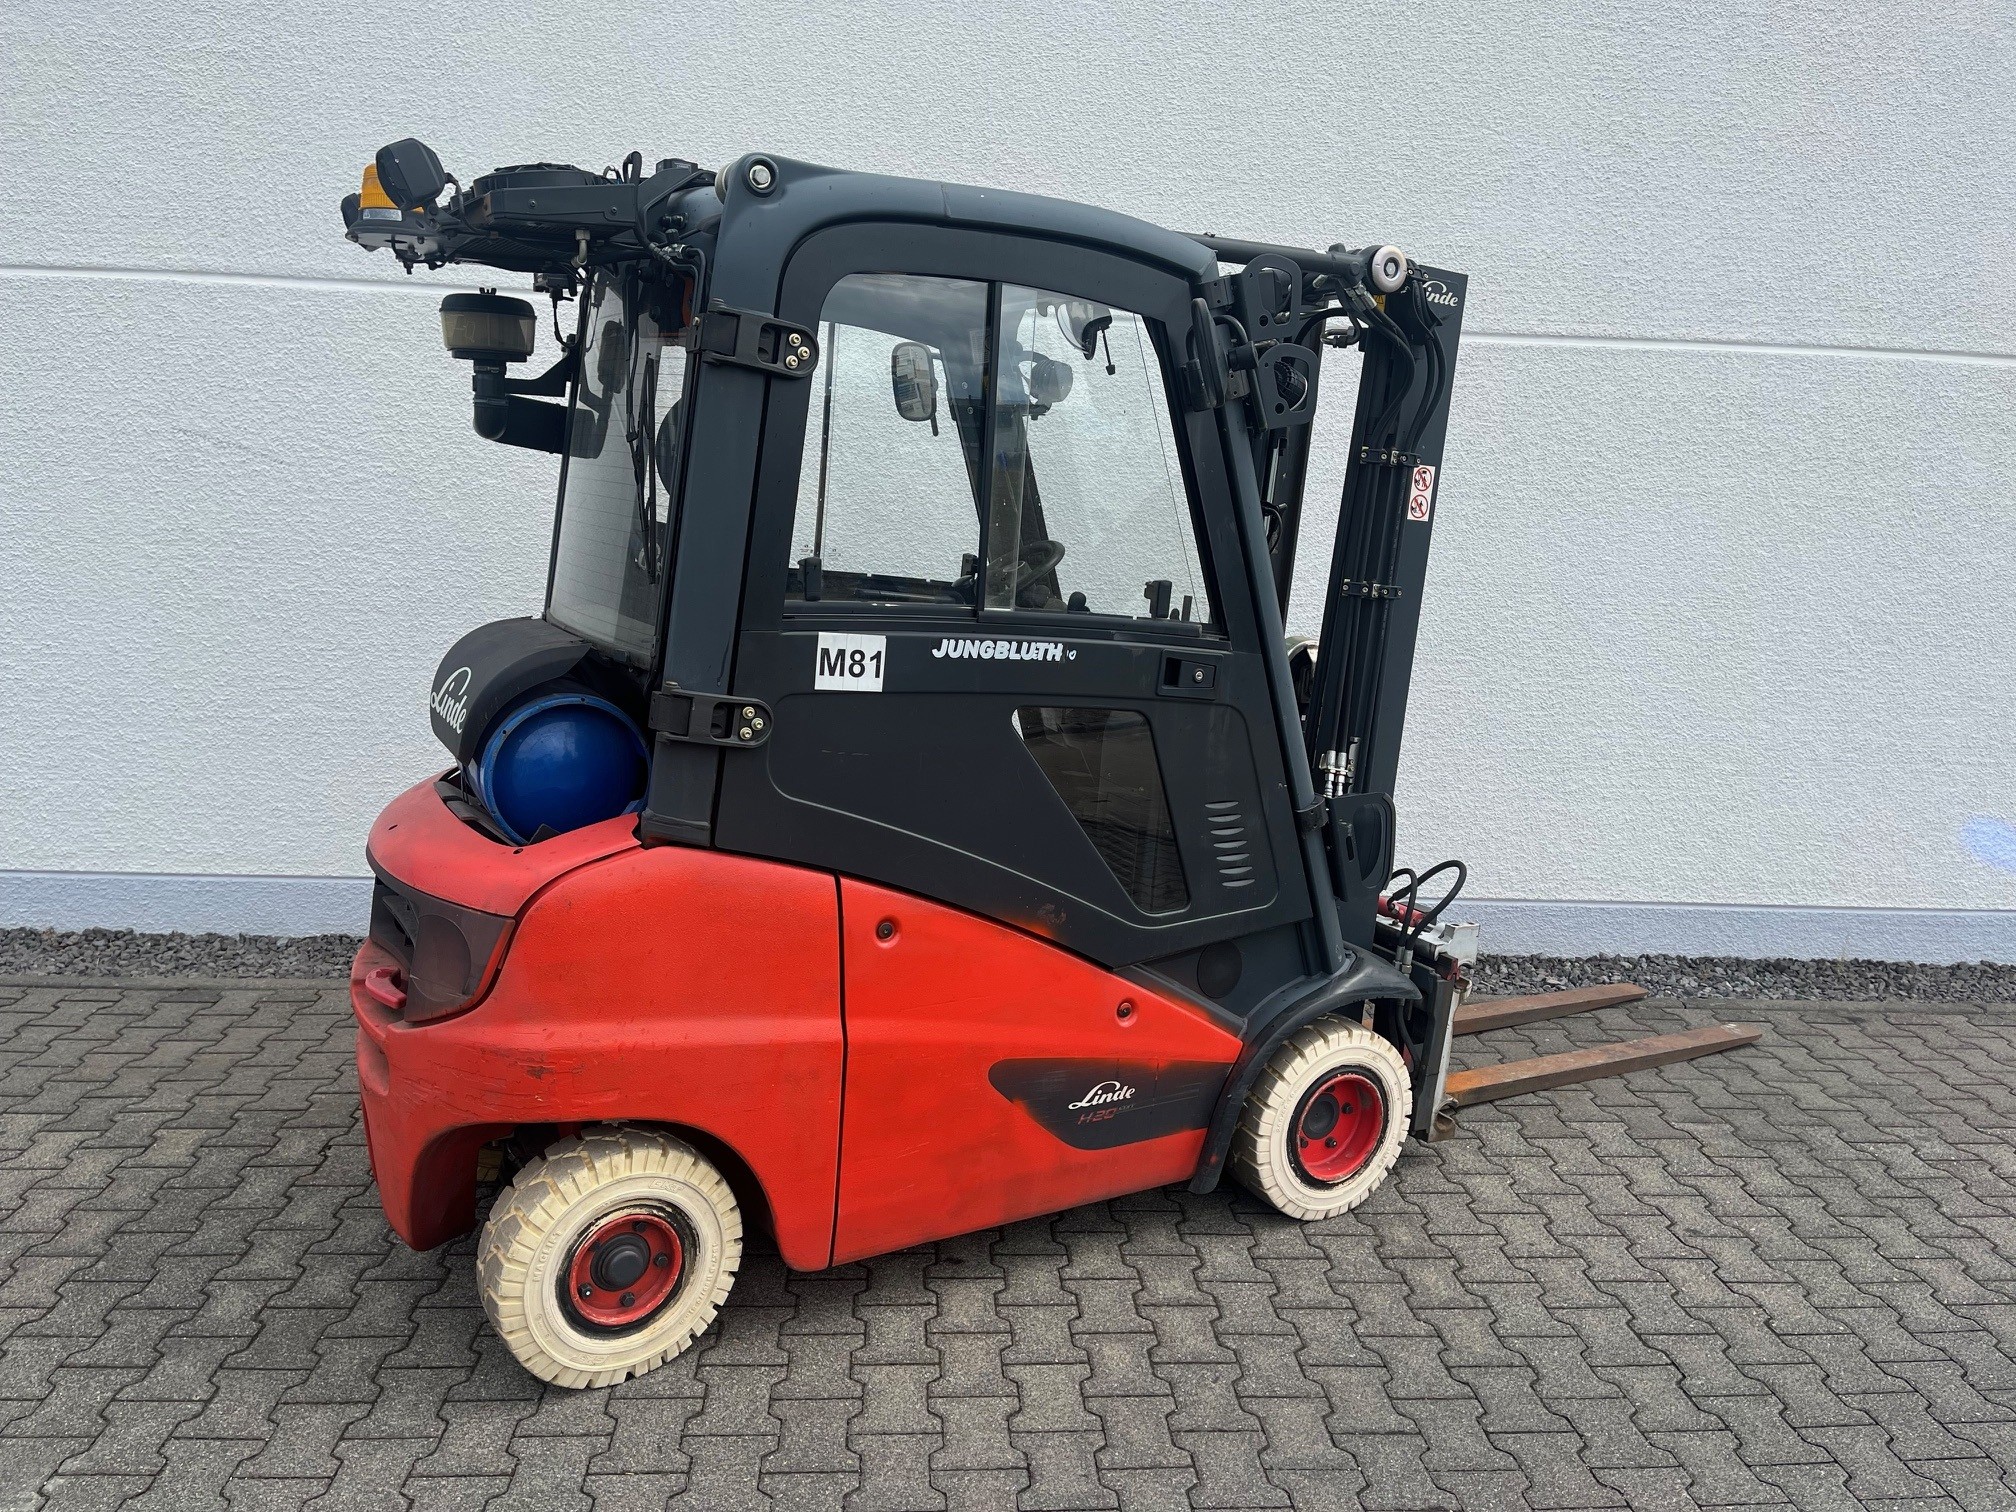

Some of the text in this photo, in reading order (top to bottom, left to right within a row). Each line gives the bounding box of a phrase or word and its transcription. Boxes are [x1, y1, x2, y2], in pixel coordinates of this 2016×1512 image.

[819, 647, 883, 679] M81
[931, 638, 1064, 662] JUNGBLUTH
[430, 666, 472, 735] Linde
[1068, 1080, 1136, 1110] Linde
